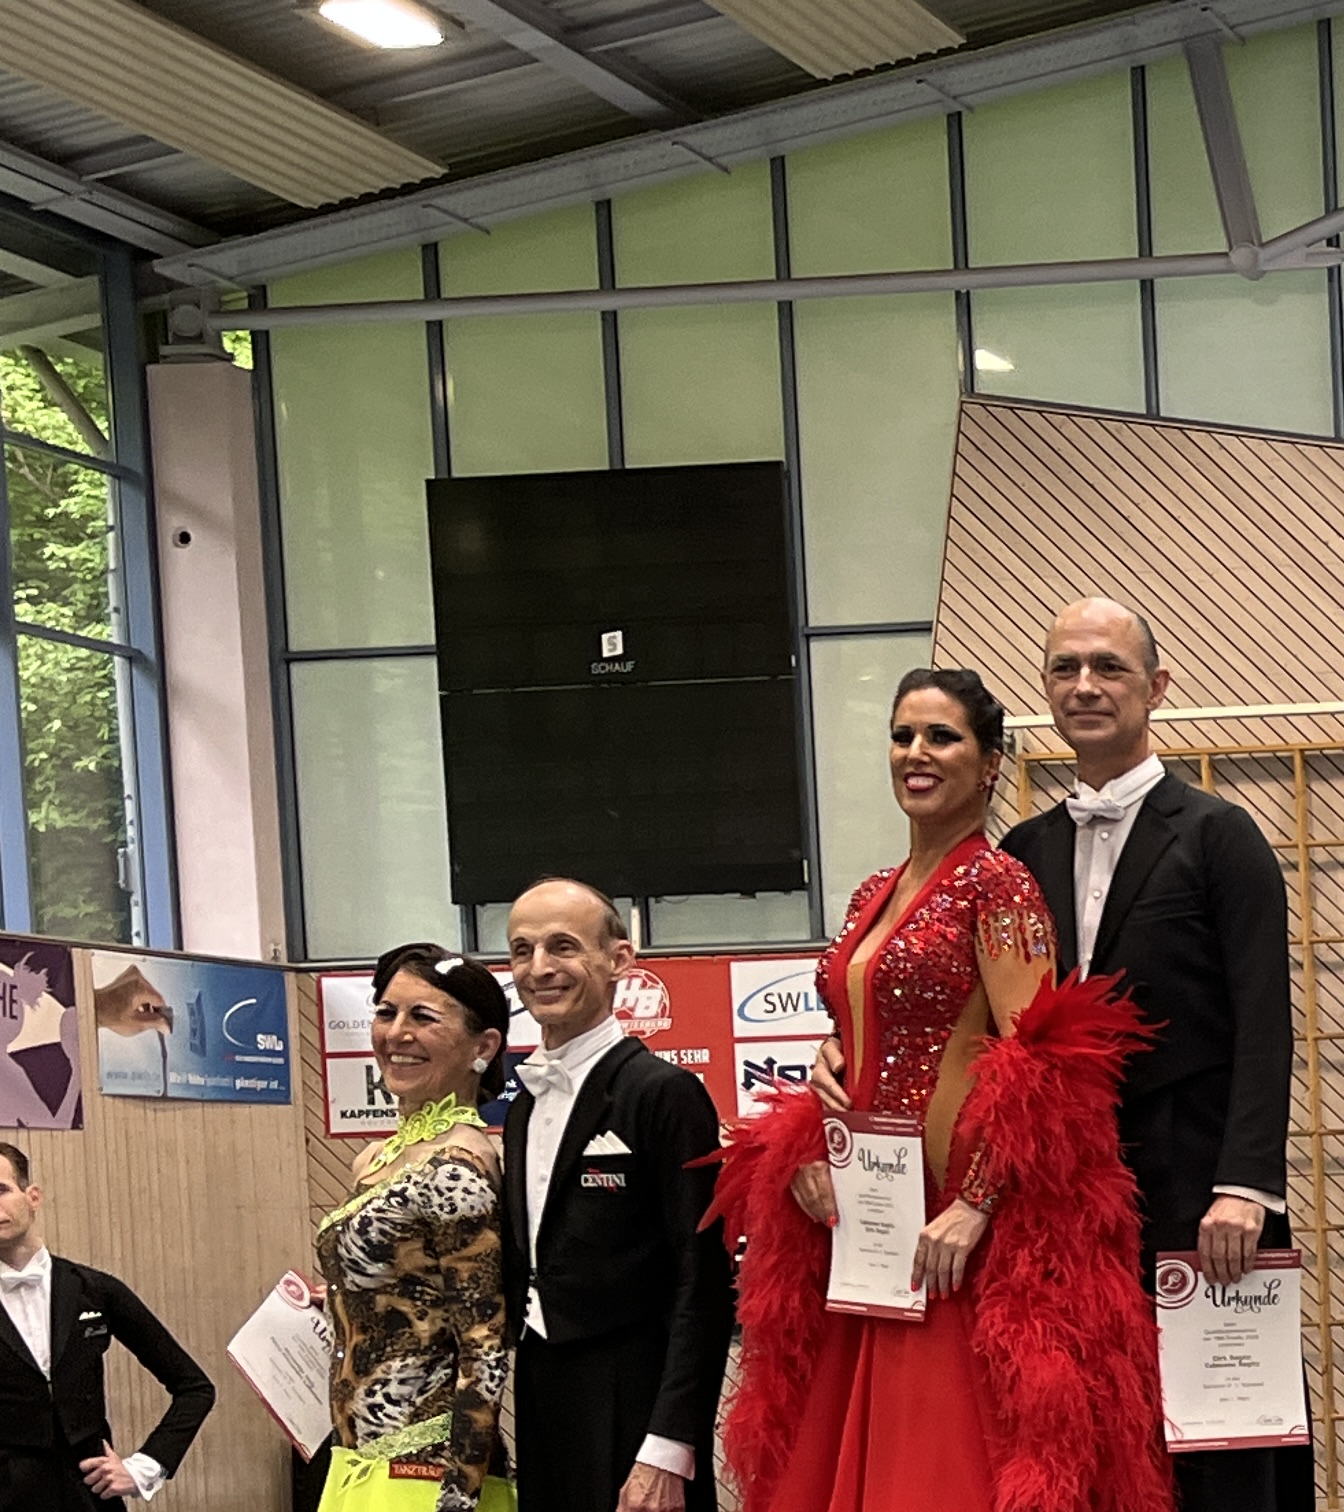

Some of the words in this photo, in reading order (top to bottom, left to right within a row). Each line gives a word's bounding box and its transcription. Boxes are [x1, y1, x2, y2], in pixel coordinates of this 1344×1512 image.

[590, 660, 636, 674] SCHAUF
[340, 1108, 400, 1120] KAPFENS
[857, 1147, 908, 1181] Urkunde
[1204, 1278, 1282, 1313] Urkunde
